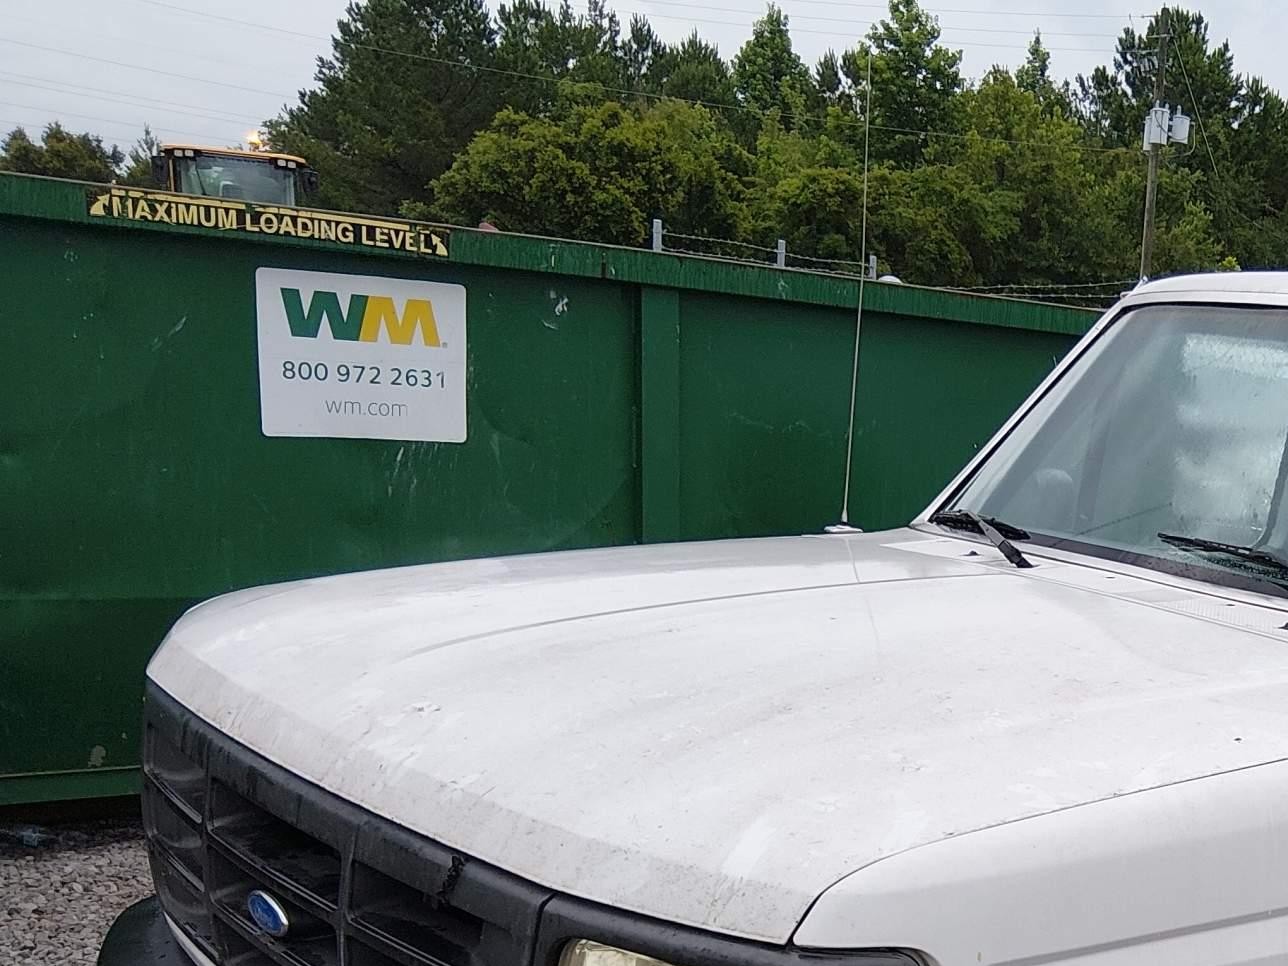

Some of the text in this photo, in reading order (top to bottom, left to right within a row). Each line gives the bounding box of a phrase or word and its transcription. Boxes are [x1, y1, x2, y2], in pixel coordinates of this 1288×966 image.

[112, 195, 433, 255] MAXIMUM LOADING LEVEL
[280, 287, 441, 348] WM
[282, 360, 446, 389] 800 972 2631
[325, 399, 409, 417] wm.com
